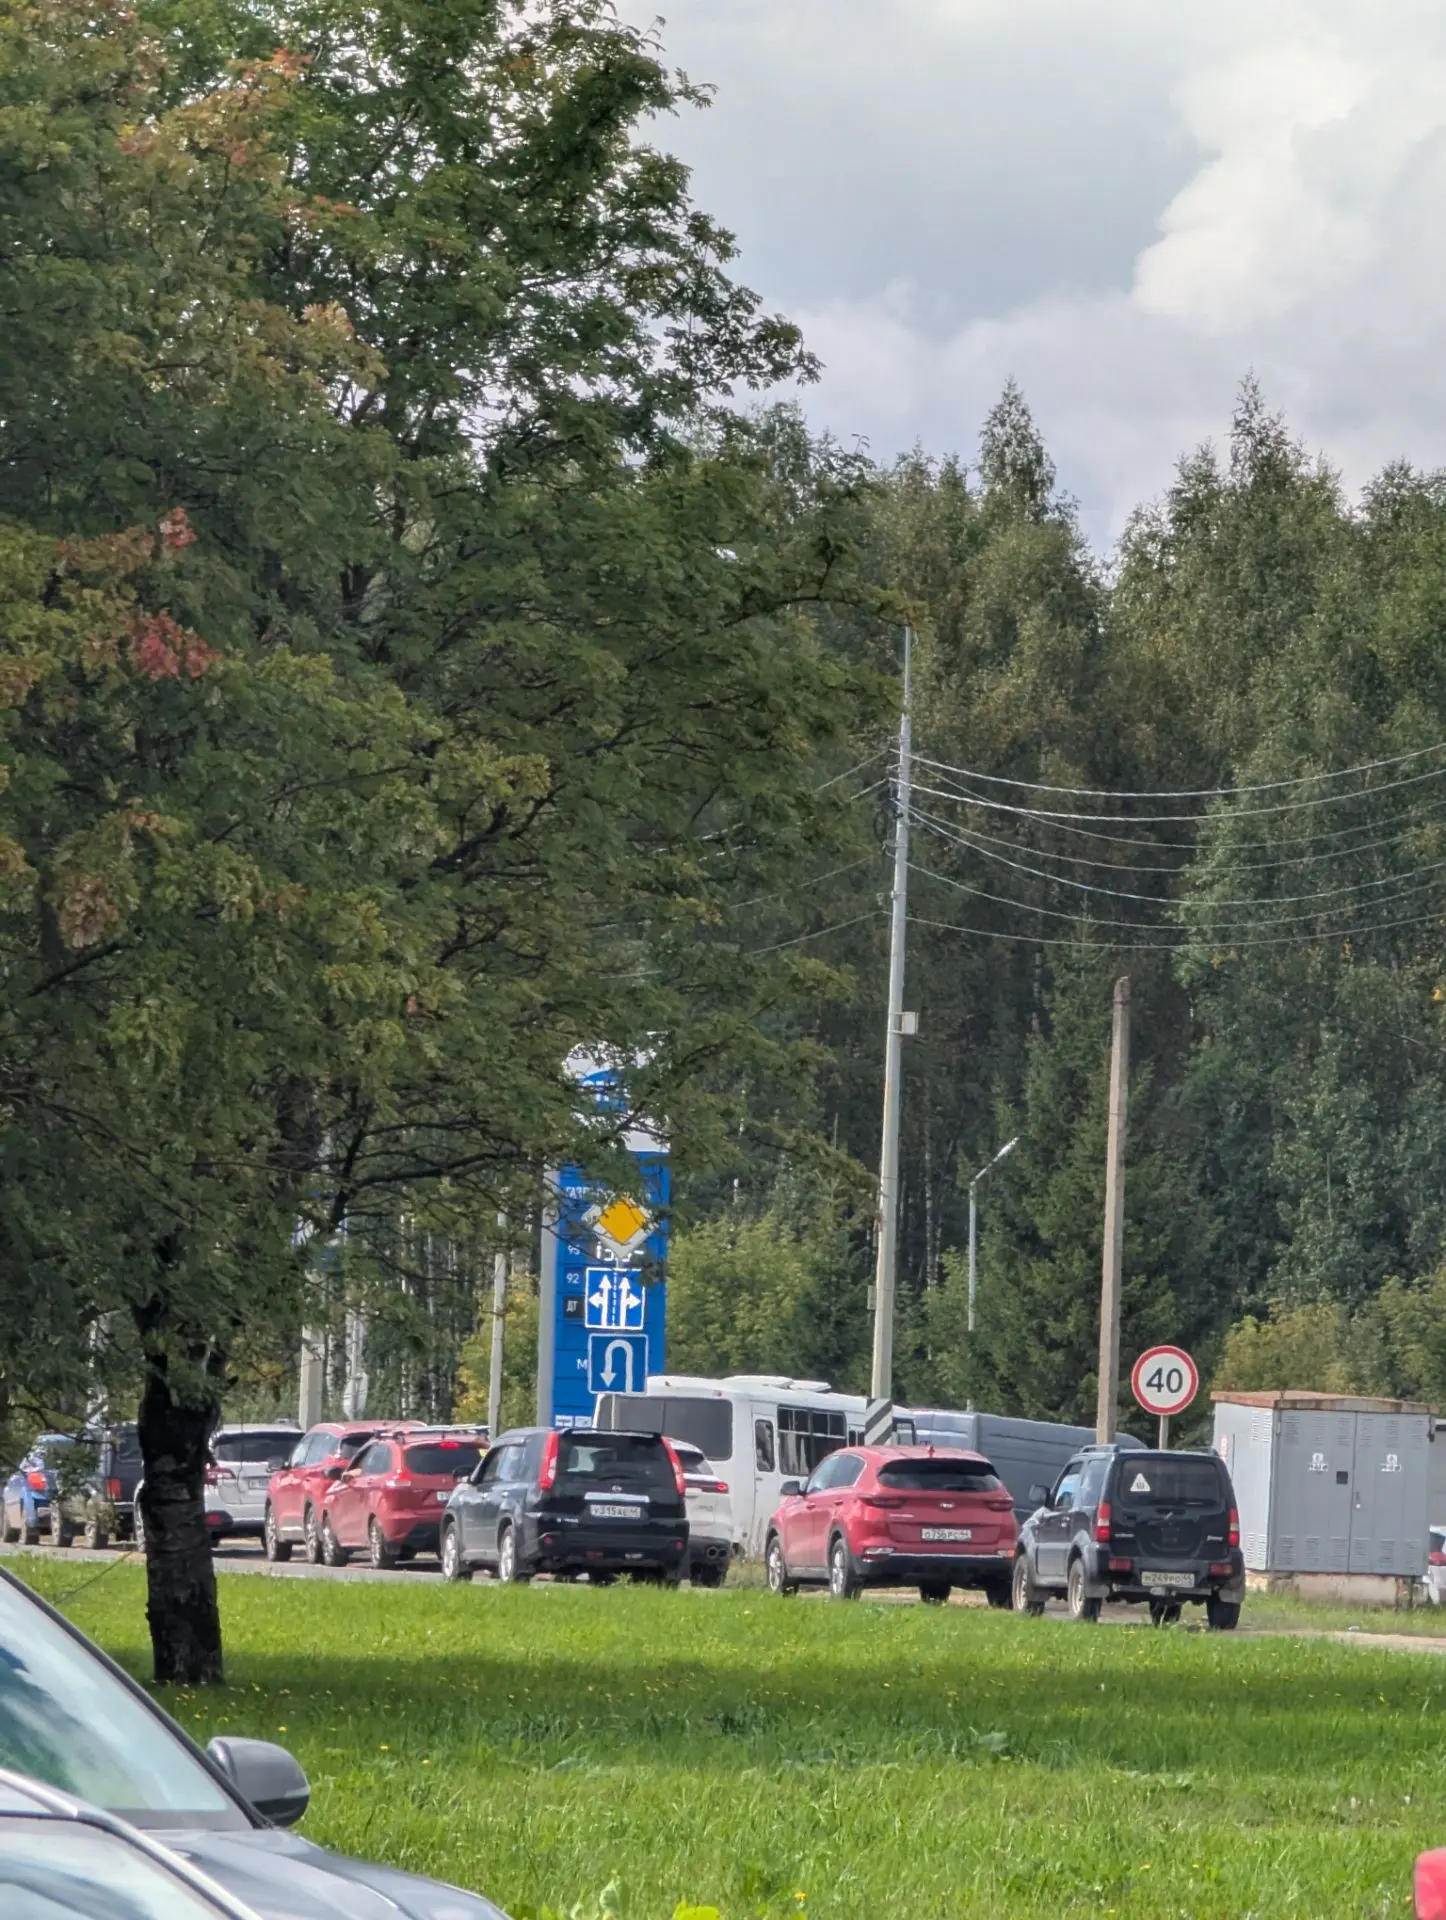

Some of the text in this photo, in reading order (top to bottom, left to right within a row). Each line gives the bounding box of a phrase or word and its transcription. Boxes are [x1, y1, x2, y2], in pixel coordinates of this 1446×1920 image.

[567, 1244, 580, 1256] 95
[566, 1272, 580, 1284] 92
[566, 1300, 579, 1312] ДТ
[1145, 1367, 1184, 1394] 40
